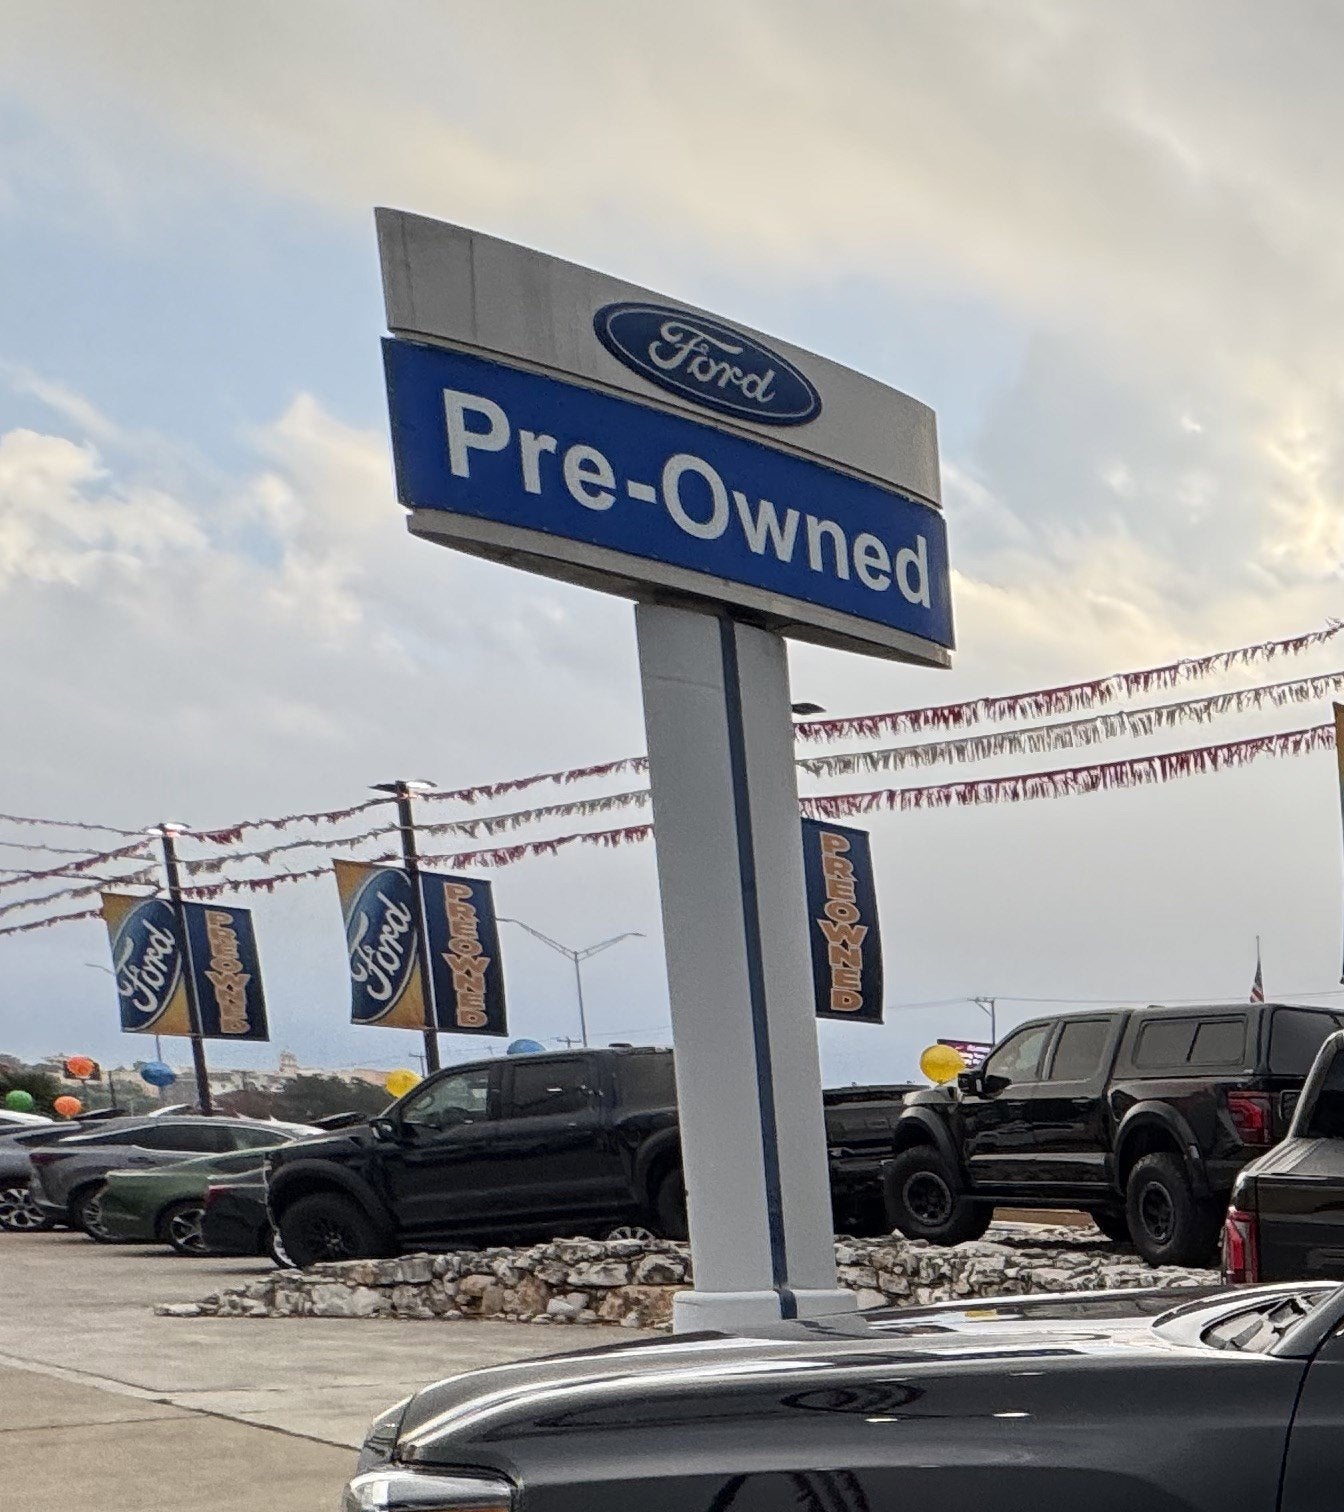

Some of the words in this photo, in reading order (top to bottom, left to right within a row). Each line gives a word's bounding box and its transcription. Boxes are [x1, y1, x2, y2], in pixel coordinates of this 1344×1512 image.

[647, 320, 776, 404] Ford
[442, 387, 932, 610] Pre-Owned
[116, 919, 176, 1013] Ford
[349, 891, 412, 1001] Ford
[441, 882, 492, 1028] PREOWNED
[816, 831, 869, 1012] PREOWNED
